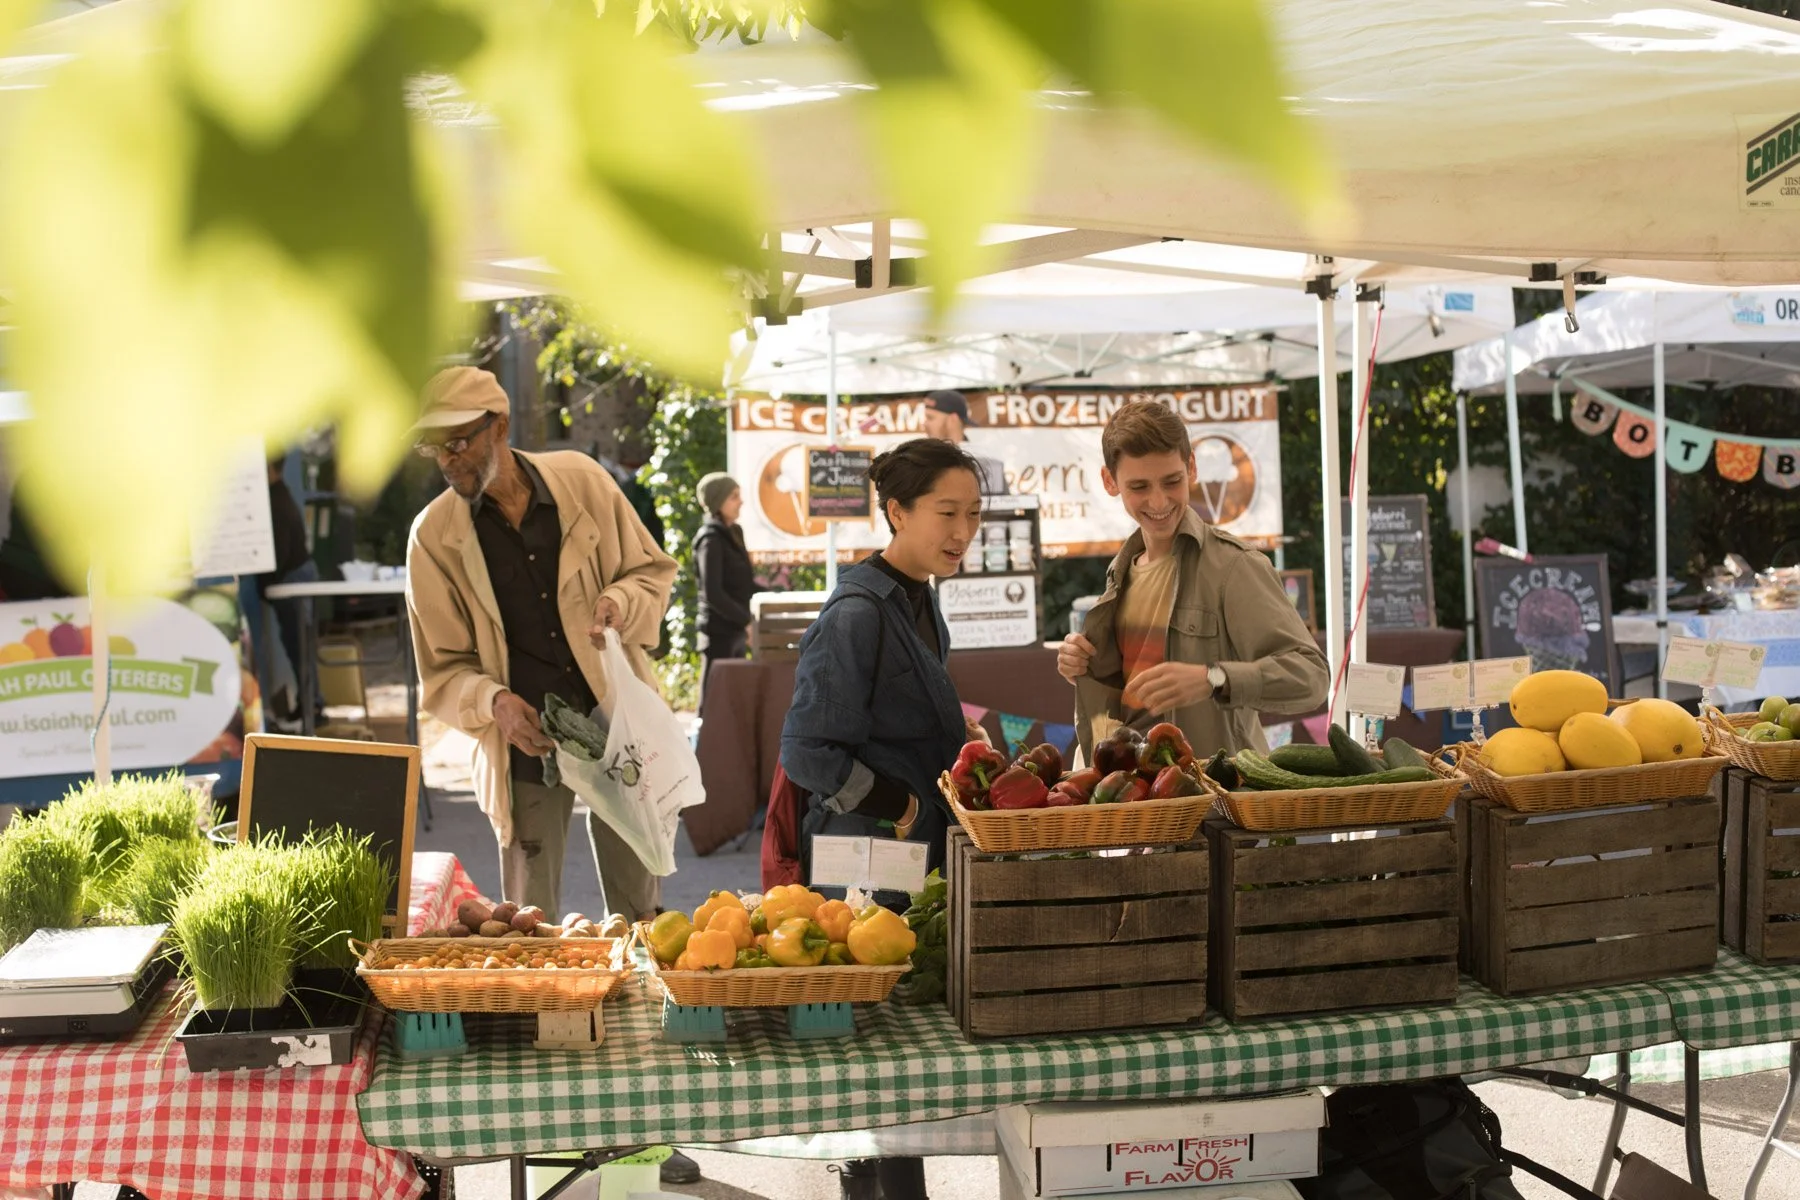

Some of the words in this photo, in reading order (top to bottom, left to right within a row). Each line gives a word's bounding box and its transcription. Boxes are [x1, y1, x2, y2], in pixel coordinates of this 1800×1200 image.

[739, 398, 795, 429] ICE
[802, 402, 926, 433] CREAM
[986, 393, 1124, 426] FROZEN
[1129, 387, 1268, 421] OGURT
[24, 671, 77, 692] PAUL
[81, 668, 185, 693] CTERERS
[0, 707, 177, 735] w.isaiahpul.com
[1115, 1142, 1175, 1155] FARM
[1184, 1137, 1248, 1150] FRESH
[1124, 1158, 1235, 1186] FLAVOR
